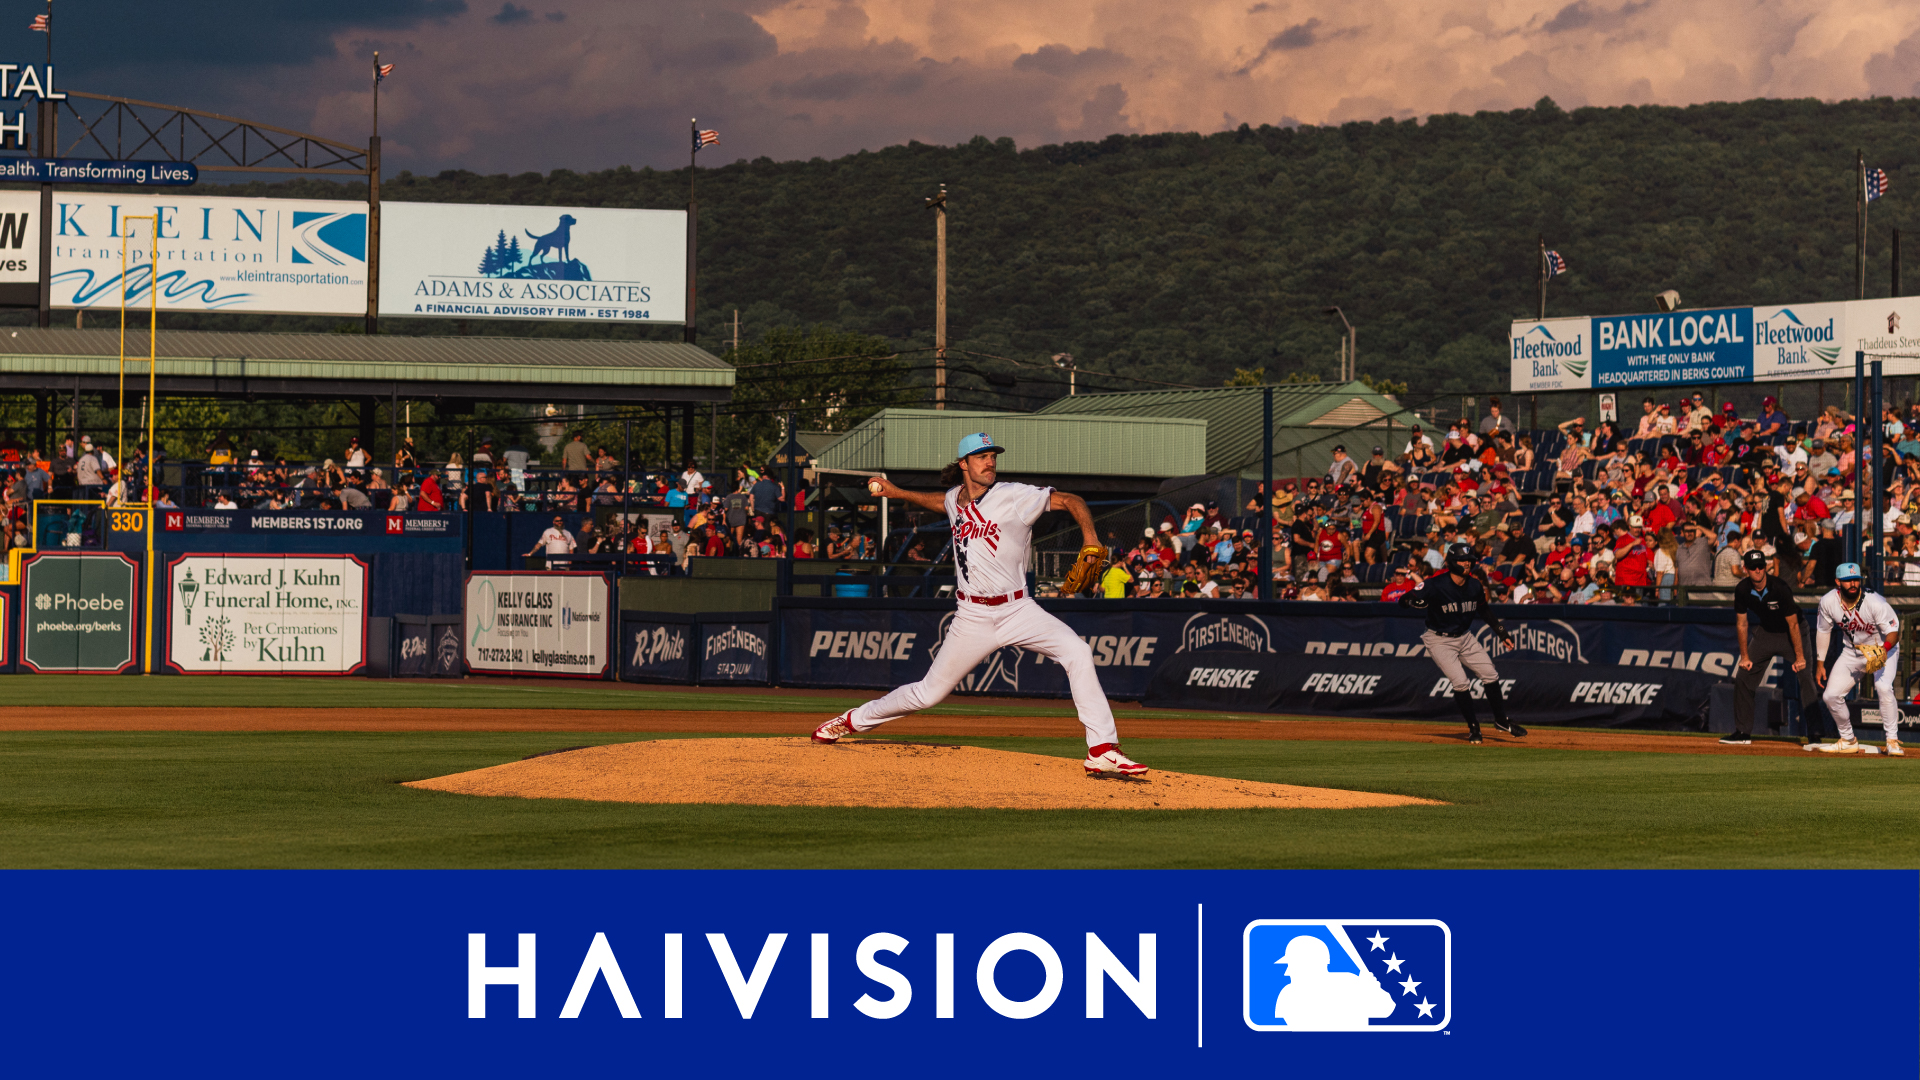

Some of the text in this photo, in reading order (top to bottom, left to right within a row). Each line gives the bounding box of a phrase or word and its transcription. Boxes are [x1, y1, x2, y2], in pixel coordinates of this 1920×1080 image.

[0, 64, 67, 99] TAL
[0, 160, 194, 183] ealth. Transforming Lives.
[56, 203, 267, 242] KLEIN
[56, 245, 264, 263] transportation
[219, 269, 364, 286] www.kleintransportation.com
[414, 279, 652, 303] ADAMS & ASSOCIATES
[414, 303, 650, 319] A FINANCIAL ADVISORY FIRM EST 1984
[1599, 313, 1744, 350] BANK LOCAL
[1755, 317, 1834, 345] Fleetwood
[1513, 333, 1582, 359] Fleetwood
[1857, 336, 1898, 350] Thaddeus
[1627, 351, 1715, 366] WITH THE ONLY BANK
[1777, 345, 1808, 365] Bank
[1533, 359, 1559, 377] Bank
[1598, 365, 1745, 385] HEADQUARTERED IN BERKS COUNTY
[1529, 381, 1551, 389] MEMBER
[111, 511, 144, 532] 330
[186, 516, 225, 524] MEMBERS
[405, 519, 441, 527] MEMBERS
[204, 567, 340, 590] Edward J. Kuhn
[54, 592, 124, 610] Phoebe
[204, 590, 358, 610] Funeral Home, INC.
[498, 592, 553, 609] KELLY GLASS
[498, 614, 553, 627] INSURANCE INC
[572, 611, 599, 622] Nationwide
[37, 621, 121, 633] phoebe.org/berks
[244, 622, 337, 635] Pet Cremations
[244, 636, 326, 662] by Kuhn
[632, 626, 685, 667] R-Phils
[810, 630, 917, 661] PENSKE
[532, 649, 595, 667] kellyglassins.com
[1186, 667, 1260, 689] PENSKE
[1301, 672, 1382, 695] PENSKE
[1570, 681, 1663, 705] PENSKE
